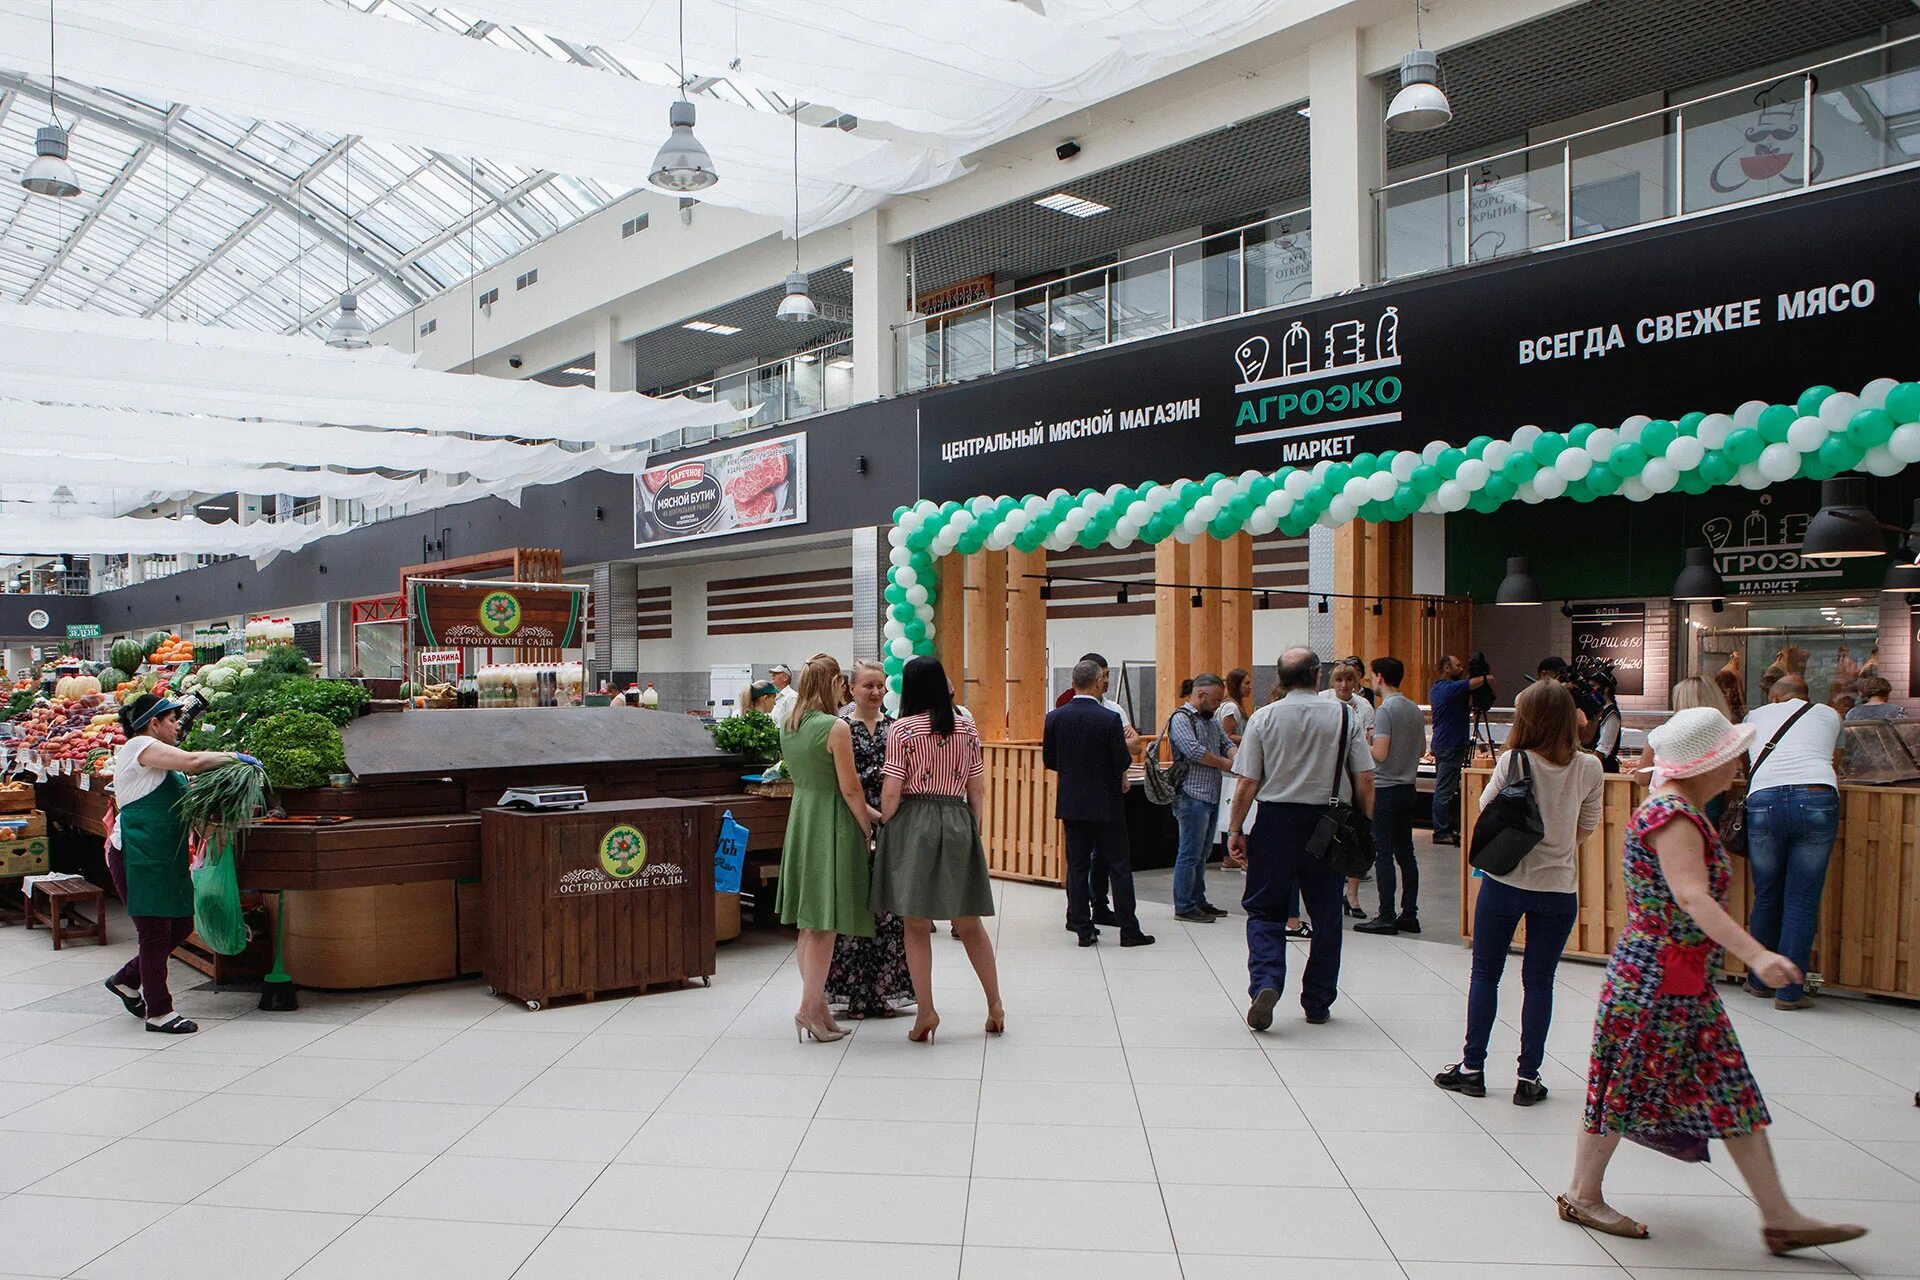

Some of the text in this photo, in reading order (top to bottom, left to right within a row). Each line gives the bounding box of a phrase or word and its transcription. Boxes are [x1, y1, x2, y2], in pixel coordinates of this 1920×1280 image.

[1470, 194, 1505, 211] КОРО
[1457, 203, 1519, 227] ОКРЫТИЕ
[1276, 263, 1310, 279] ОТКРЫ
[1518, 278, 1876, 365] ВСЕГДА СВЕЖЕЕ МЯСО
[1235, 375, 1403, 427] АГРОЭКО
[941, 397, 1201, 464] ЦЕНТРАЛЬНЫЙ МЯСНОЙ МАГАЗИН
[1282, 435, 1356, 463] МАРКЕТ
[670, 468, 702, 483] ЗАРЕЧНОЕ
[657, 488, 716, 510] МЯСНОЙ БУТИК
[69, 629, 99, 638] ЗЕЛЕНЬ
[445, 636, 554, 647] ОСТРОГОЖСКИЕ САДЫ
[422, 653, 460, 663] БАРАНИНА
[560, 876, 683, 894] ОСТРОГОЖСКИЕ САДЫ
